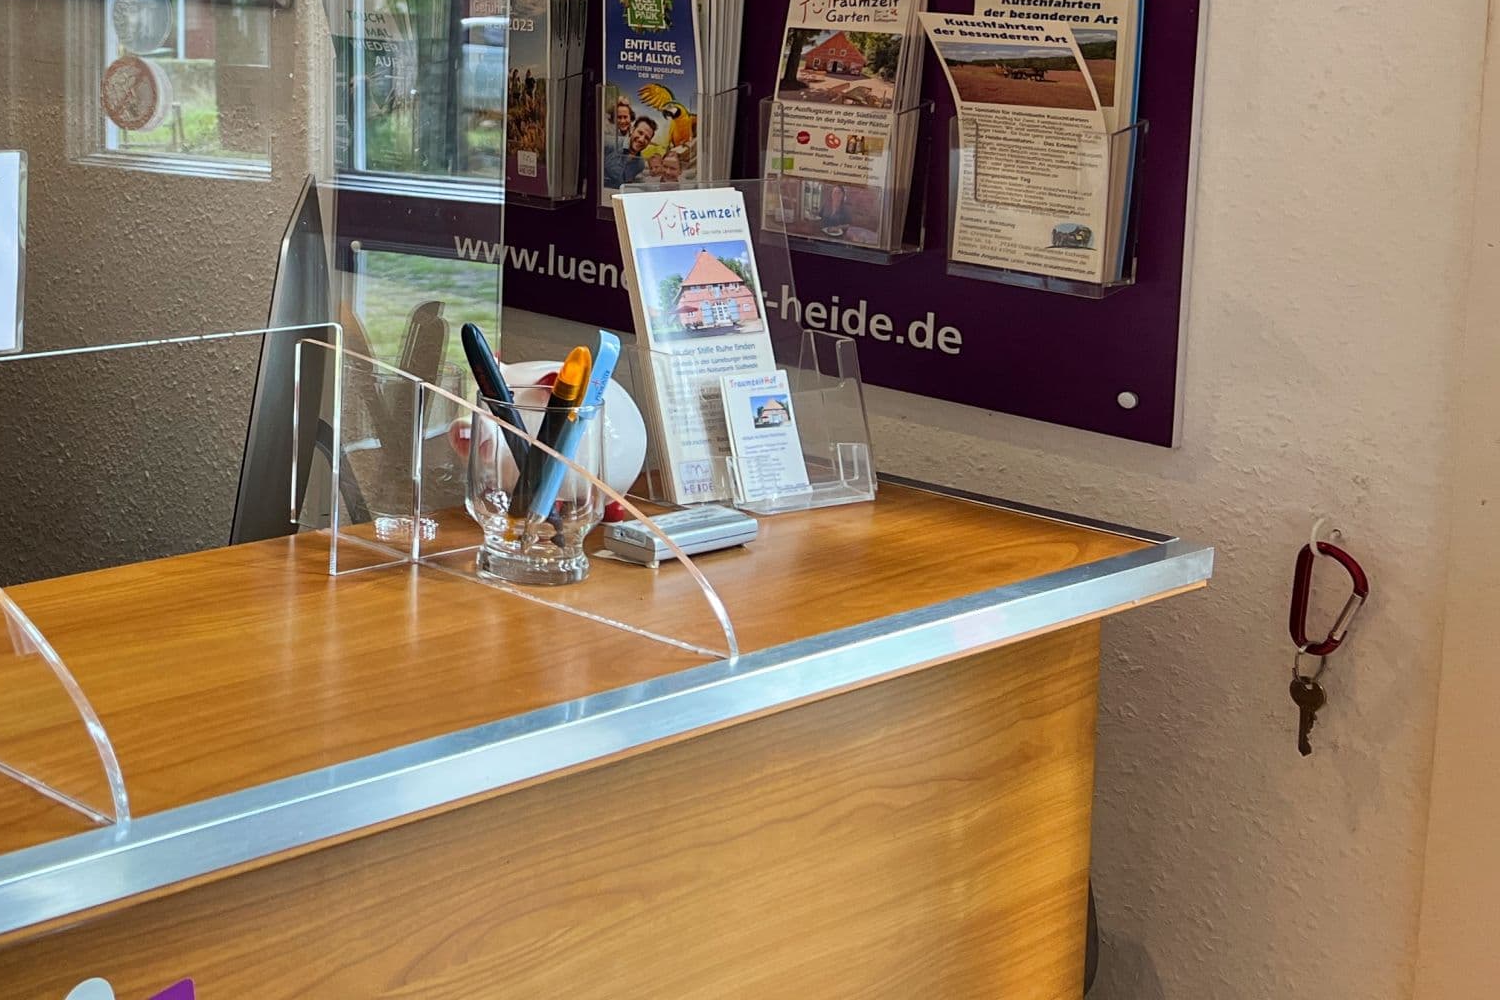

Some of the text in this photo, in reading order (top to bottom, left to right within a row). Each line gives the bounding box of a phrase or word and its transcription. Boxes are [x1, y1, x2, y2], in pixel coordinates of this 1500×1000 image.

[631, 2, 661, 13] VOGEL
[635, 10, 659, 21] PARK
[825, 9, 870, 23] Garten
[984, 8, 1119, 25] der besonderen Art
[944, 18, 1045, 32] Kutschfahrten
[933, 28, 1068, 44] der besonderen Art
[624, 38, 677, 53] ENTFLIEGE
[620, 51, 682, 66] DEM ALLTAG
[672, 203, 741, 220] Traumzeit
[682, 222, 700, 237] Hof
